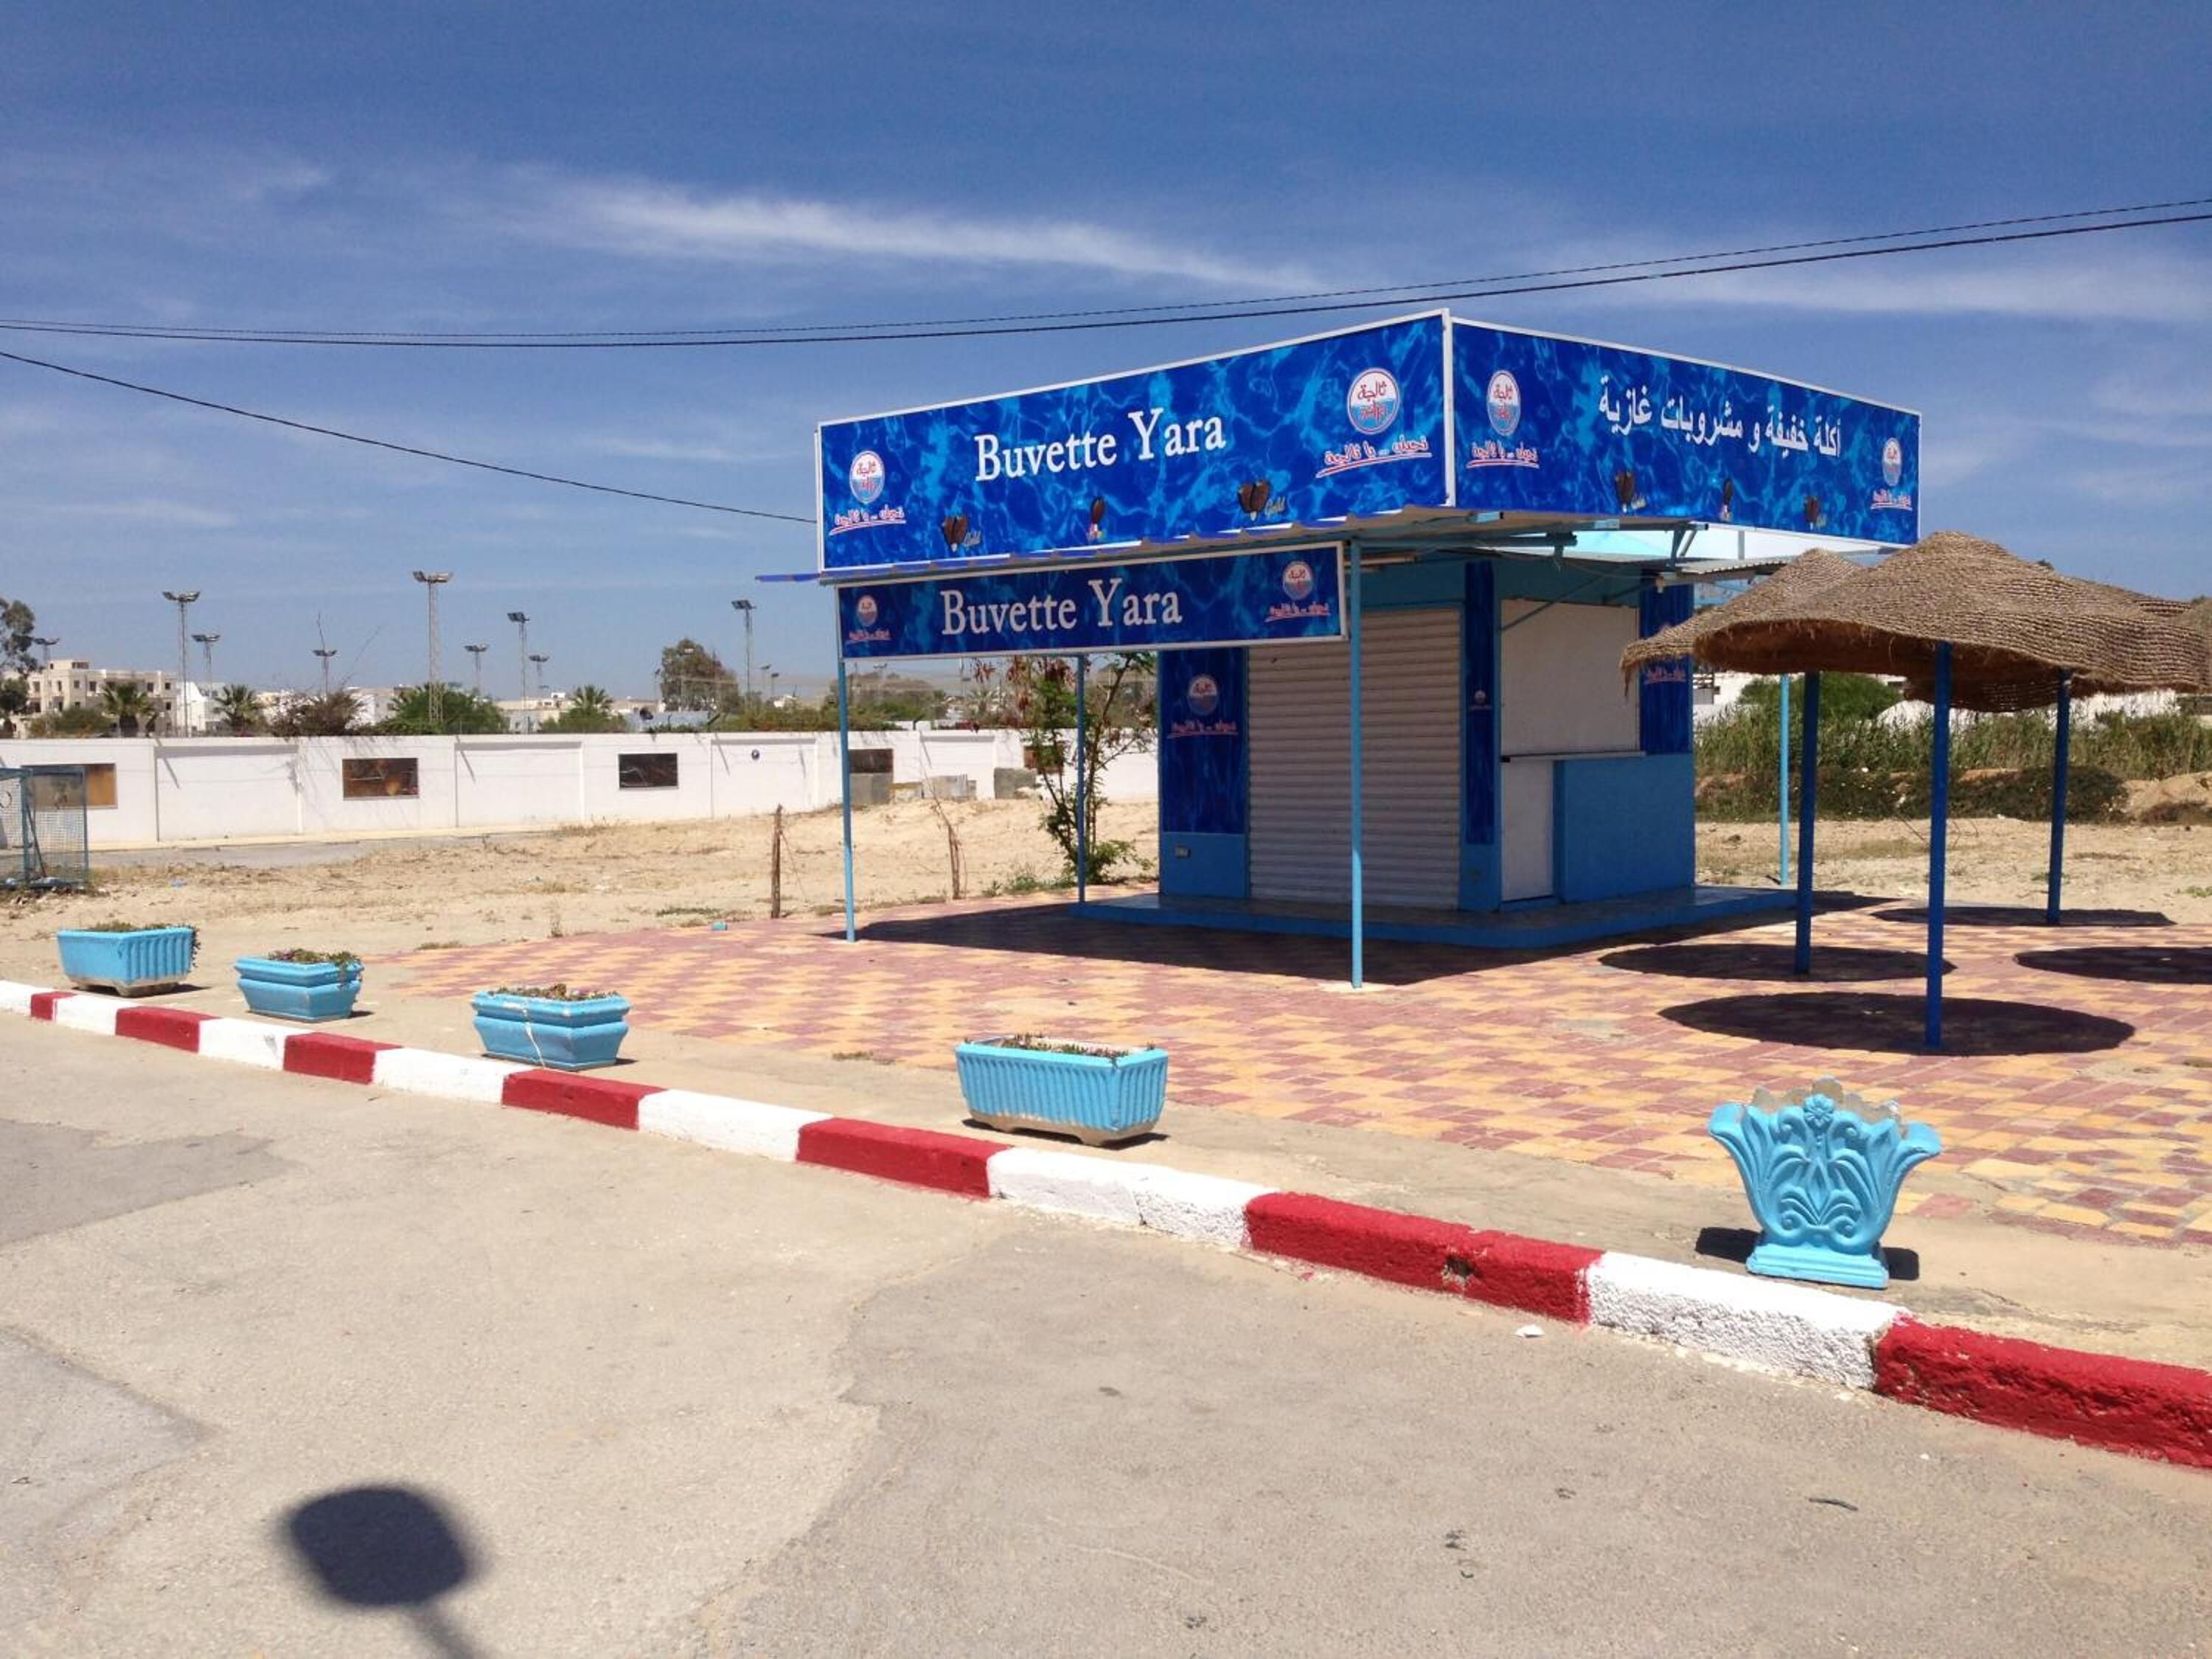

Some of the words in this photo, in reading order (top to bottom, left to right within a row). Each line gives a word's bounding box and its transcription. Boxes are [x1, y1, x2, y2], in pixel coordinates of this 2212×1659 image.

[1599, 374, 1652, 435] غازية
[1660, 394, 1744, 446] مشروبات
[1765, 404, 1809, 459] خفيفة
[974, 431, 1117, 481] Buvette
[1127, 407, 1227, 461] Yara
[1747, 422, 1760, 453] و
[1813, 414, 1841, 457] أكلة
[940, 589, 1077, 635] Buvette
[1088, 577, 1183, 627] Yara
